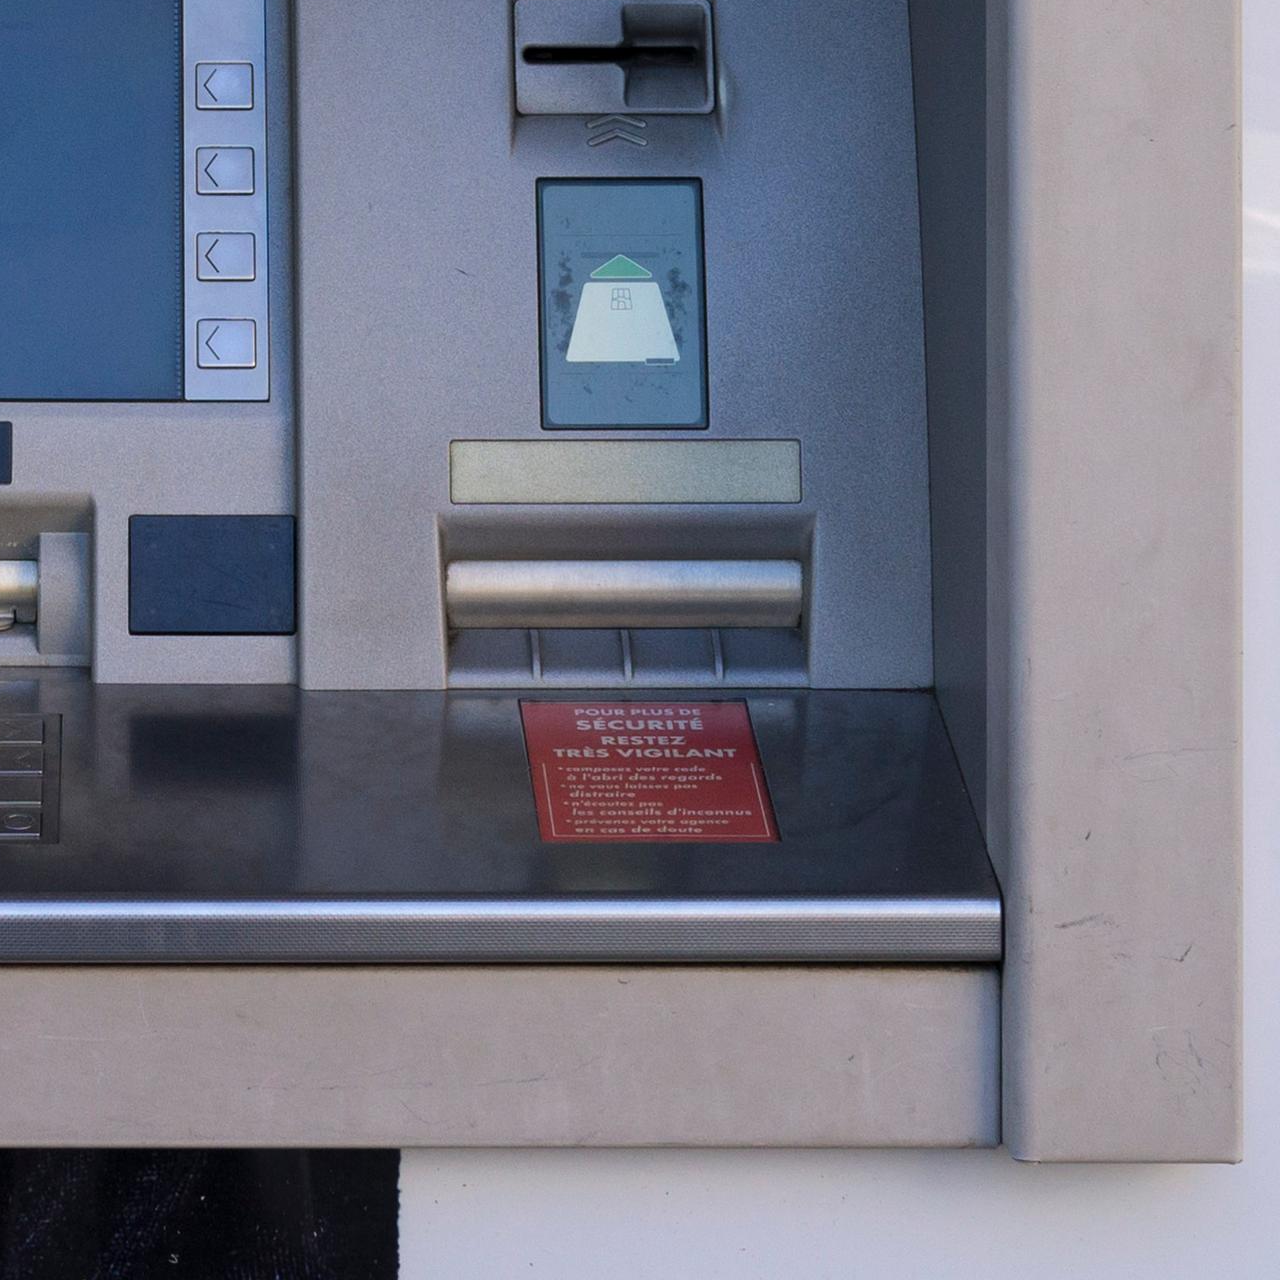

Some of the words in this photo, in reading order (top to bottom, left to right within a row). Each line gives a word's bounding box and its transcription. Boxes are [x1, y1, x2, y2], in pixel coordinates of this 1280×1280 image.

[574, 708, 625, 716] POUR
[630, 708, 675, 716] PLUS
[680, 708, 701, 716] DE
[576, 717, 704, 731] SÉCURITÉ
[601, 736, 687, 745] RESTEZ
[553, 746, 610, 758] TRÈS
[616, 748, 736, 758] VIGILANT
[674, 765, 706, 773] code
[628, 772, 656, 781] des
[661, 772, 722, 782] regards
[569, 789, 636, 798] distraire
[599, 807, 663, 816] conseils
[667, 807, 753, 816] d'inconnus
[631, 825, 652, 833] de
[657, 824, 704, 833] doute
